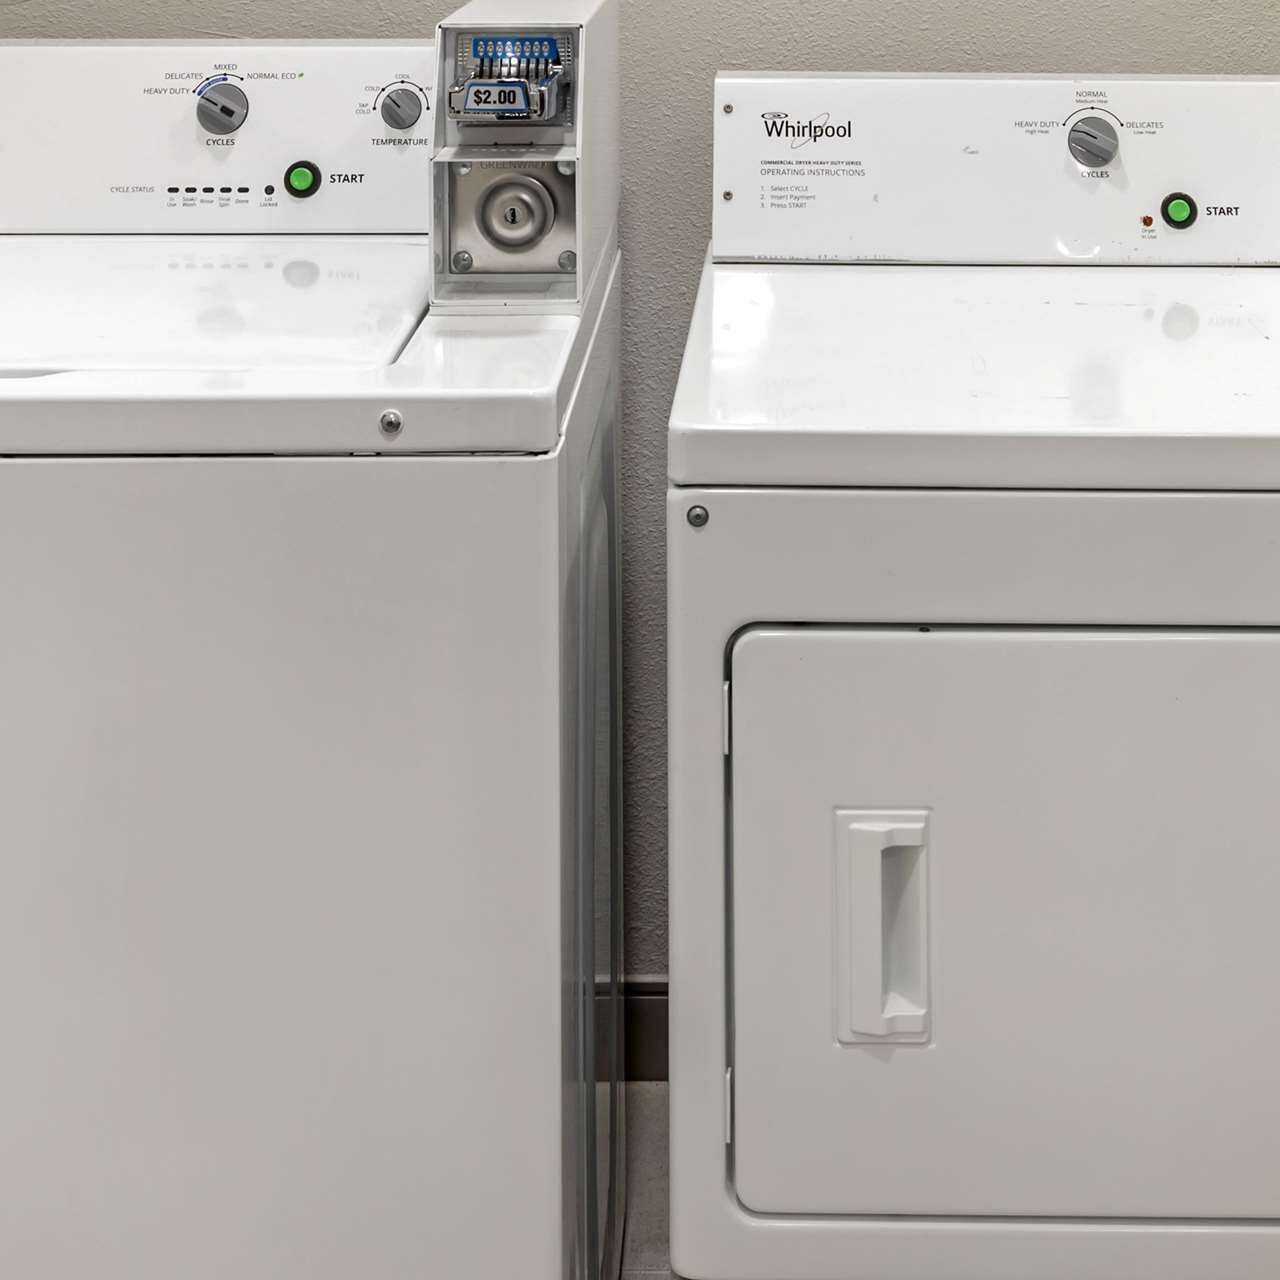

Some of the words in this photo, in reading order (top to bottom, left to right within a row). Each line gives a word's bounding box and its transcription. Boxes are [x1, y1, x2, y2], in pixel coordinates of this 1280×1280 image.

[214, 63, 237, 71] MIXED
[164, 72, 204, 80] DELICATES
[246, 72, 279, 80] NORMAL
[281, 72, 296, 80] ECO
[143, 87, 167, 95] HEAVY
[169, 87, 190, 95] DUTY
[473, 89, 517, 106] $2.00
[1126, 121, 1164, 129] DELICATES
[764, 120, 851, 142] Whirlpool
[206, 138, 236, 146] CYCLES
[371, 138, 429, 146] TEMPERATURE
[760, 168, 806, 176] OPERATING
[807, 168, 866, 176] INSTRUCTIONS
[329, 174, 365, 184] START
[1205, 206, 1240, 216] START
